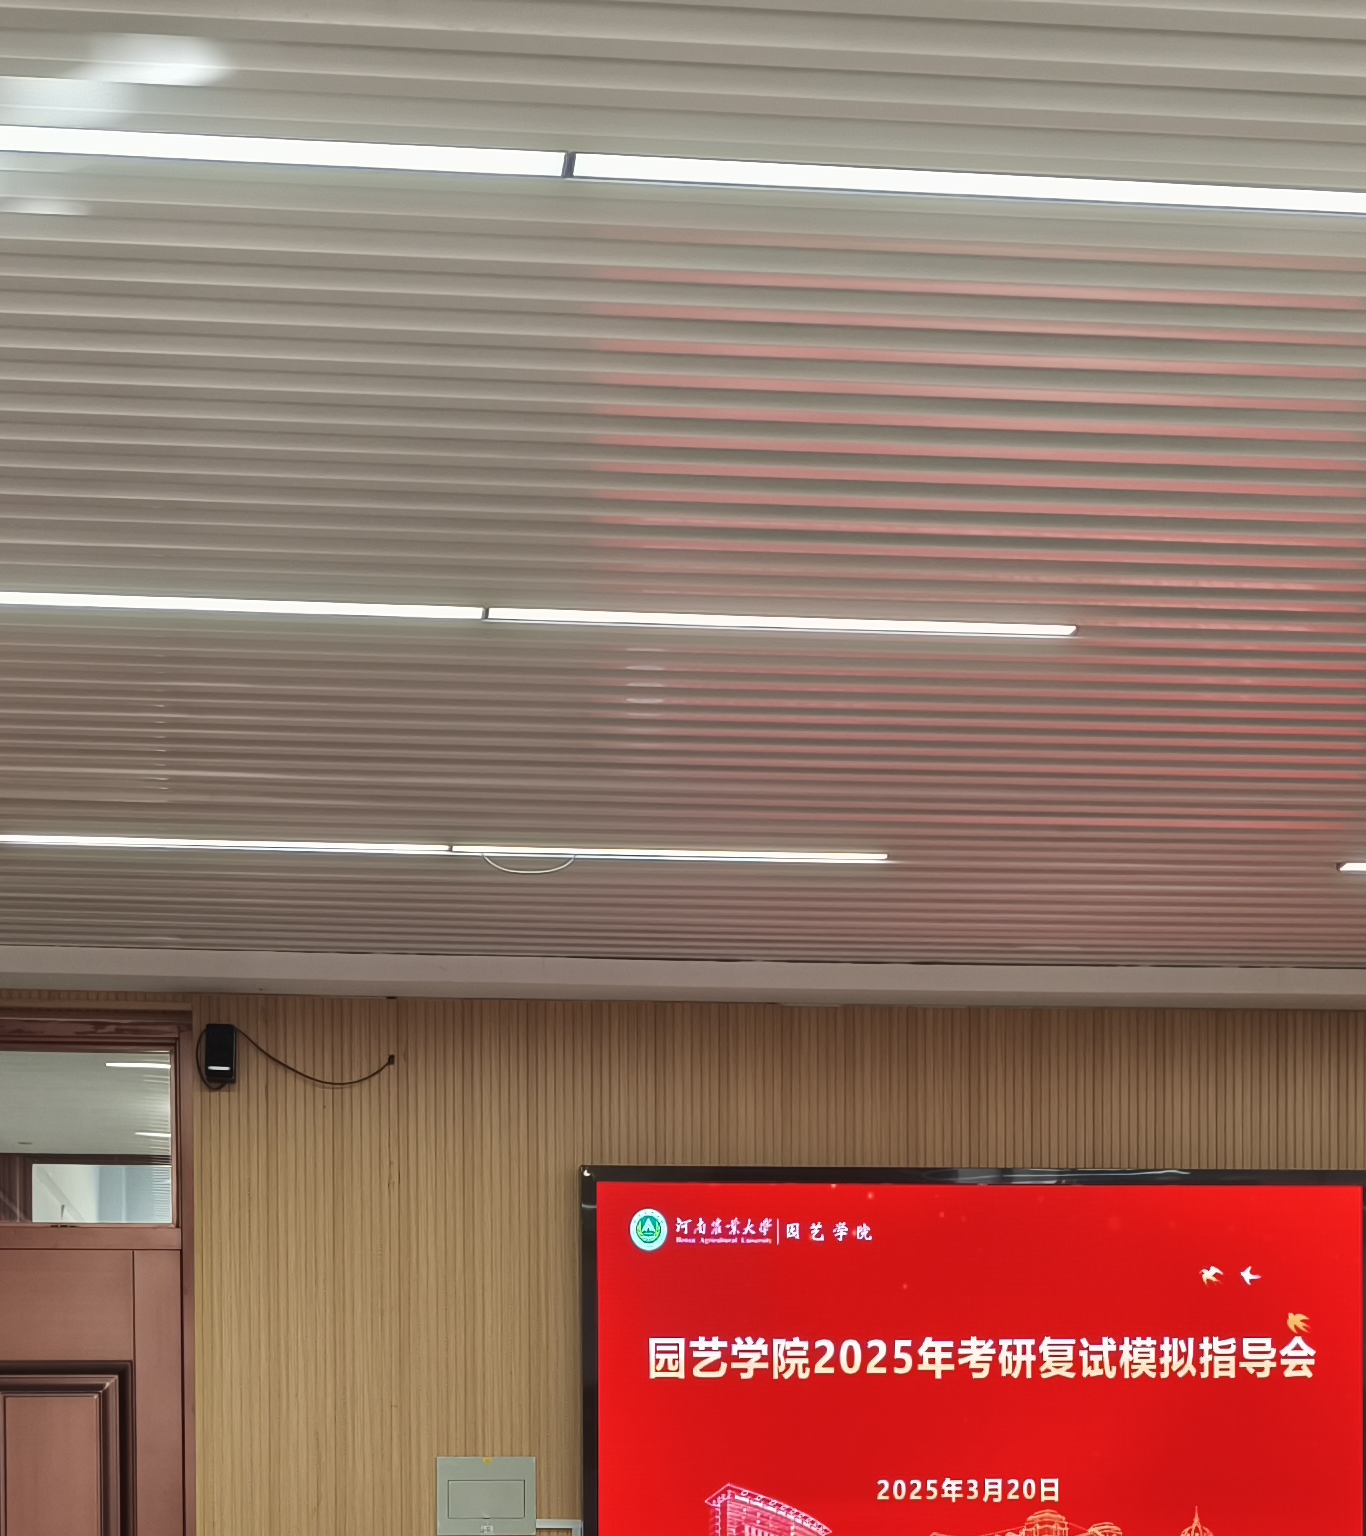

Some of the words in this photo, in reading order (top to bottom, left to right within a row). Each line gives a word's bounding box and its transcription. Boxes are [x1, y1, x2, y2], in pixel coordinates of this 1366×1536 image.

[786, 1222, 873, 1242] 园艺学院
[648, 1334, 1317, 1380] 园艺学院2025年考研复试模拟指导会
[876, 1477, 1061, 1503] 2025年3月20日
